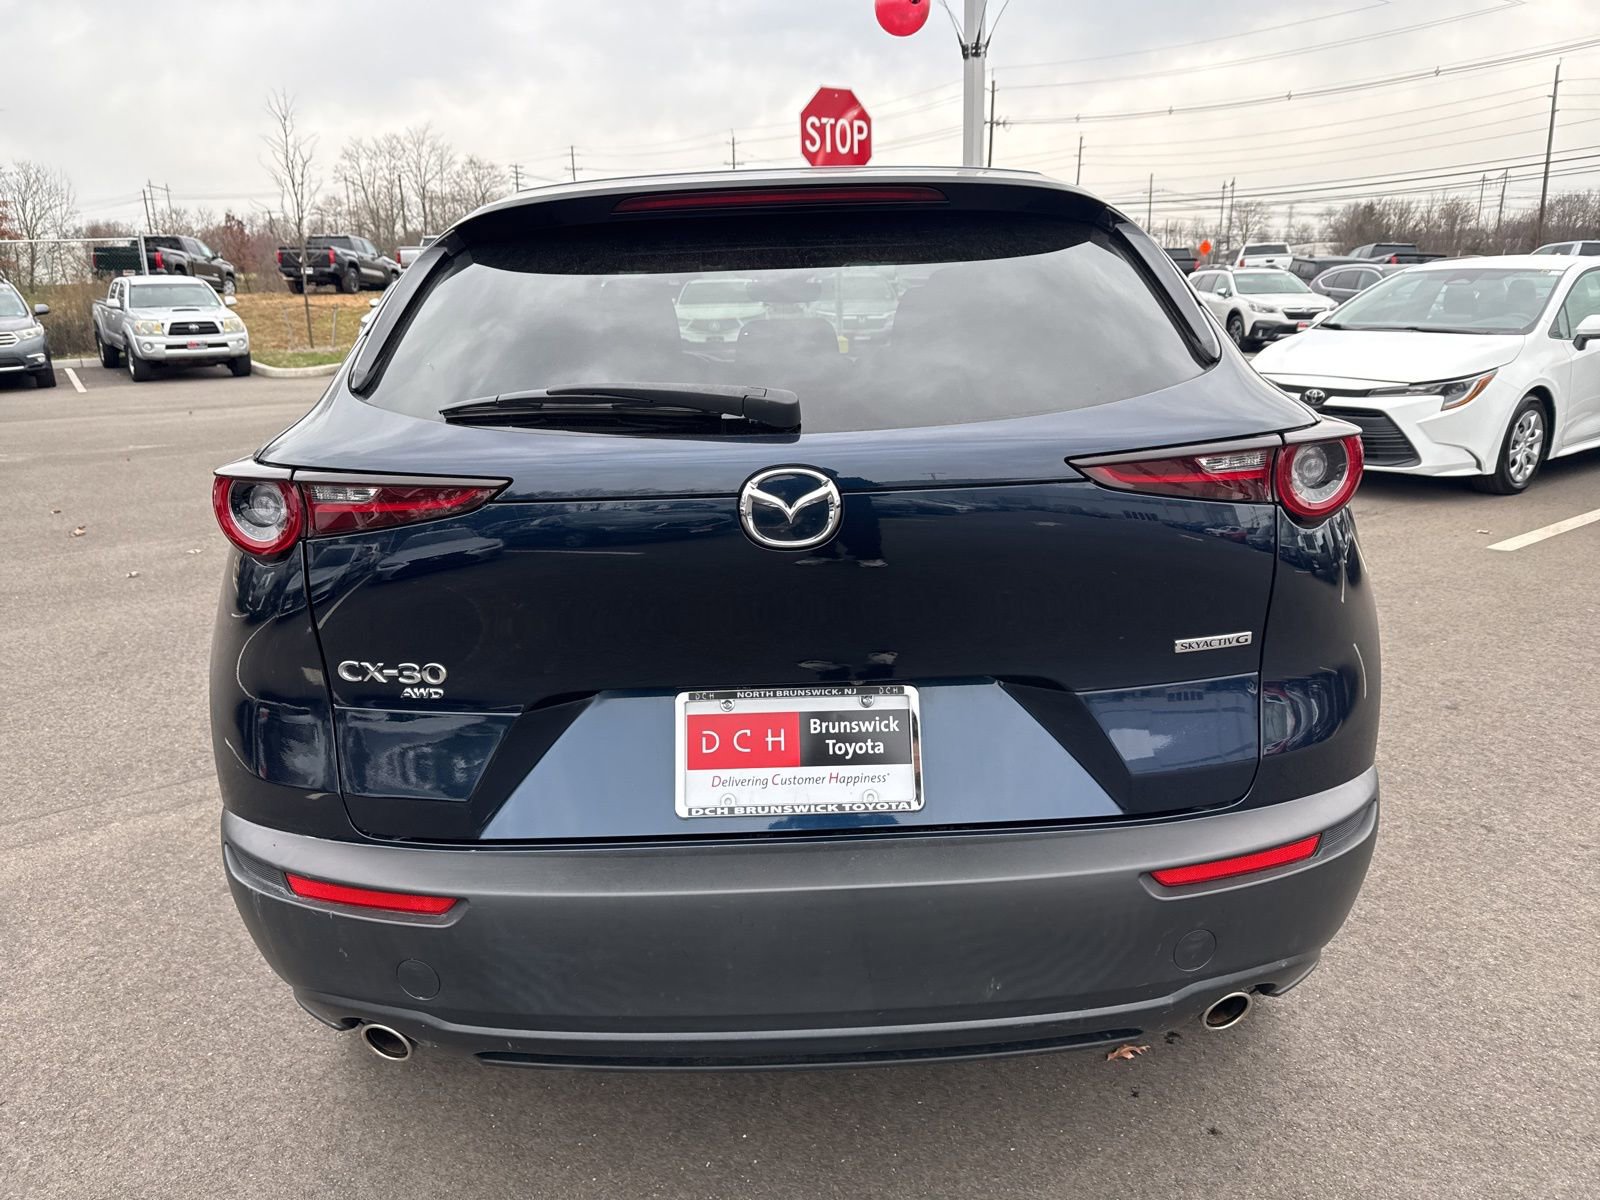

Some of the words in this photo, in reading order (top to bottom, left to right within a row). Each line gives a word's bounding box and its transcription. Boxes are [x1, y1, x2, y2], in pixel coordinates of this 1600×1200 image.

[805, 116, 868, 154] STOP
[337, 660, 447, 685] CX-30
[400, 687, 444, 699] AWD
[736, 690, 773, 698] NORTH
[844, 687, 857, 695] NJ
[810, 716, 900, 735] Brunswick
[825, 739, 884, 759] Toyota
[711, 775, 769, 789] Delivering
[771, 774, 826, 786] Customer
[691, 806, 731, 816] DCH
[734, 803, 838, 815] BRUNSWICK
[842, 801, 910, 811] TOYOTA
